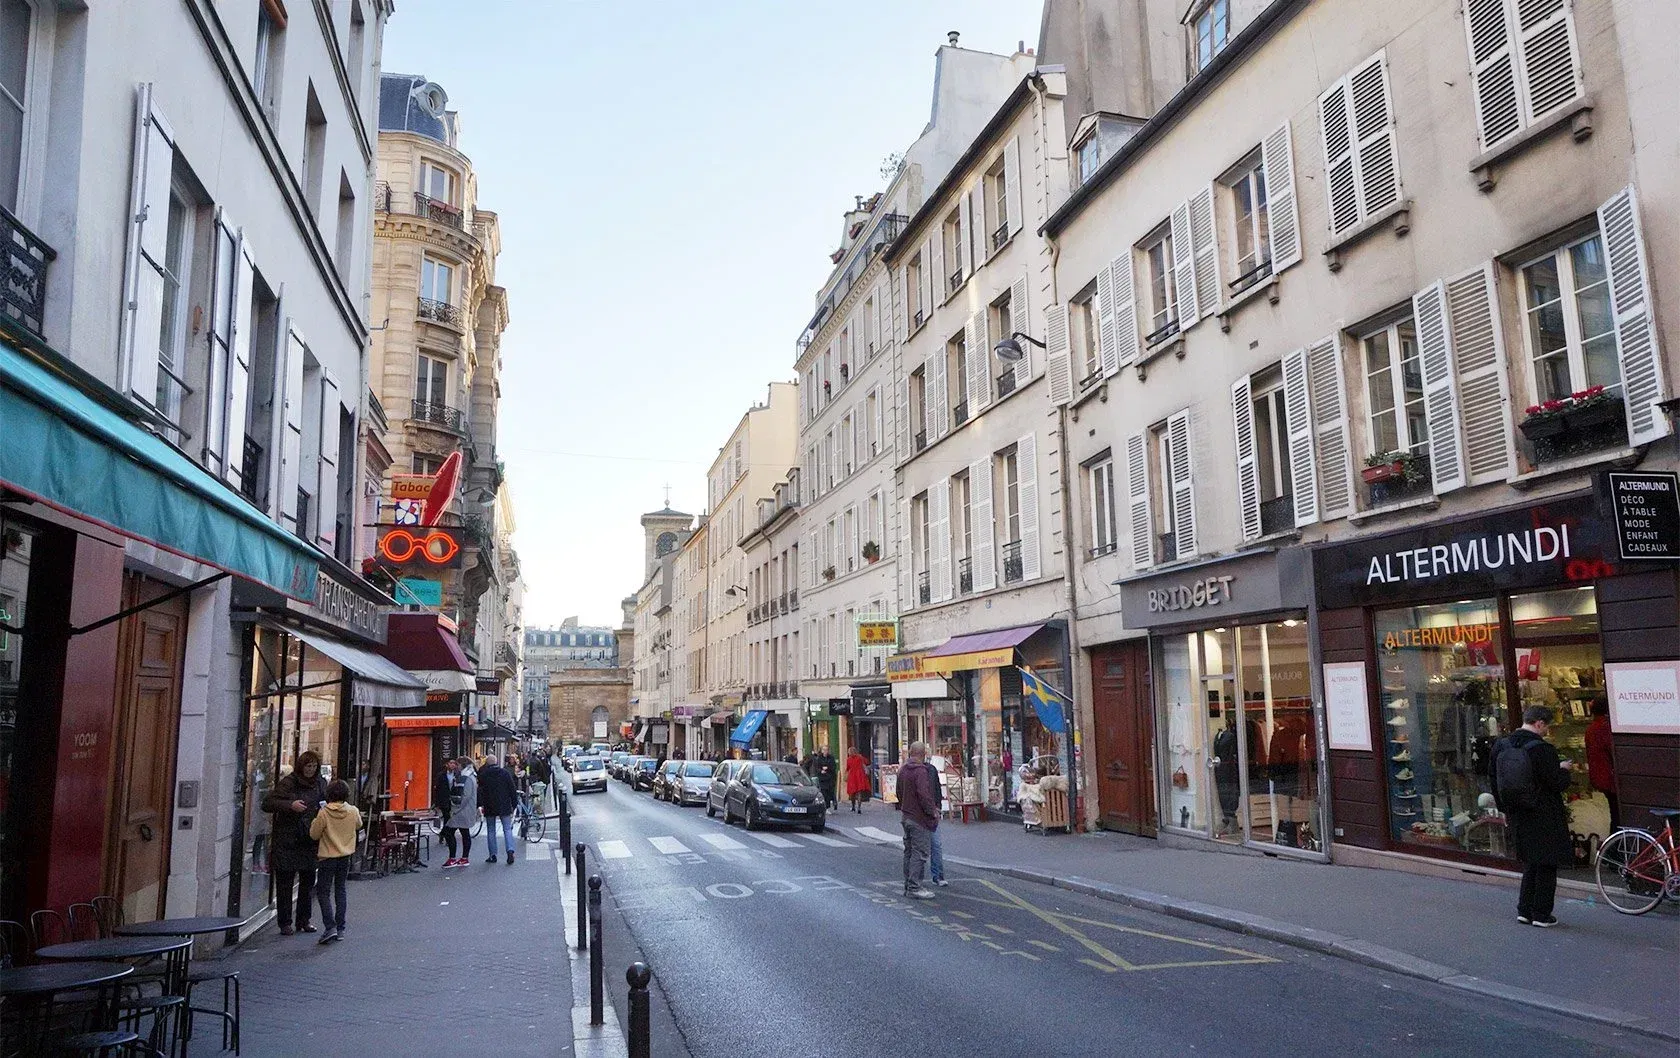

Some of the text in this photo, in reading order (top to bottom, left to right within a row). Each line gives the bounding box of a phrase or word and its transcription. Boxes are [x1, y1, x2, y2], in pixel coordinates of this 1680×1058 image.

[393, 481, 431, 493] Tabac
[1619, 481, 1669, 491] ALTERMUNDI
[1620, 494, 1645, 504] DÉCO
[1630, 507, 1657, 516] TABLE
[1624, 520, 1651, 528] MODE
[1626, 531, 1658, 540] ENFANT
[1628, 543, 1668, 552] CADEAUX
[1366, 523, 1571, 585] ALTERMUNDI
[1147, 575, 1234, 612] BRIDGET
[1384, 624, 1493, 648] ALTERMUNDI
[1618, 692, 1676, 700] ALTERMUNDI
